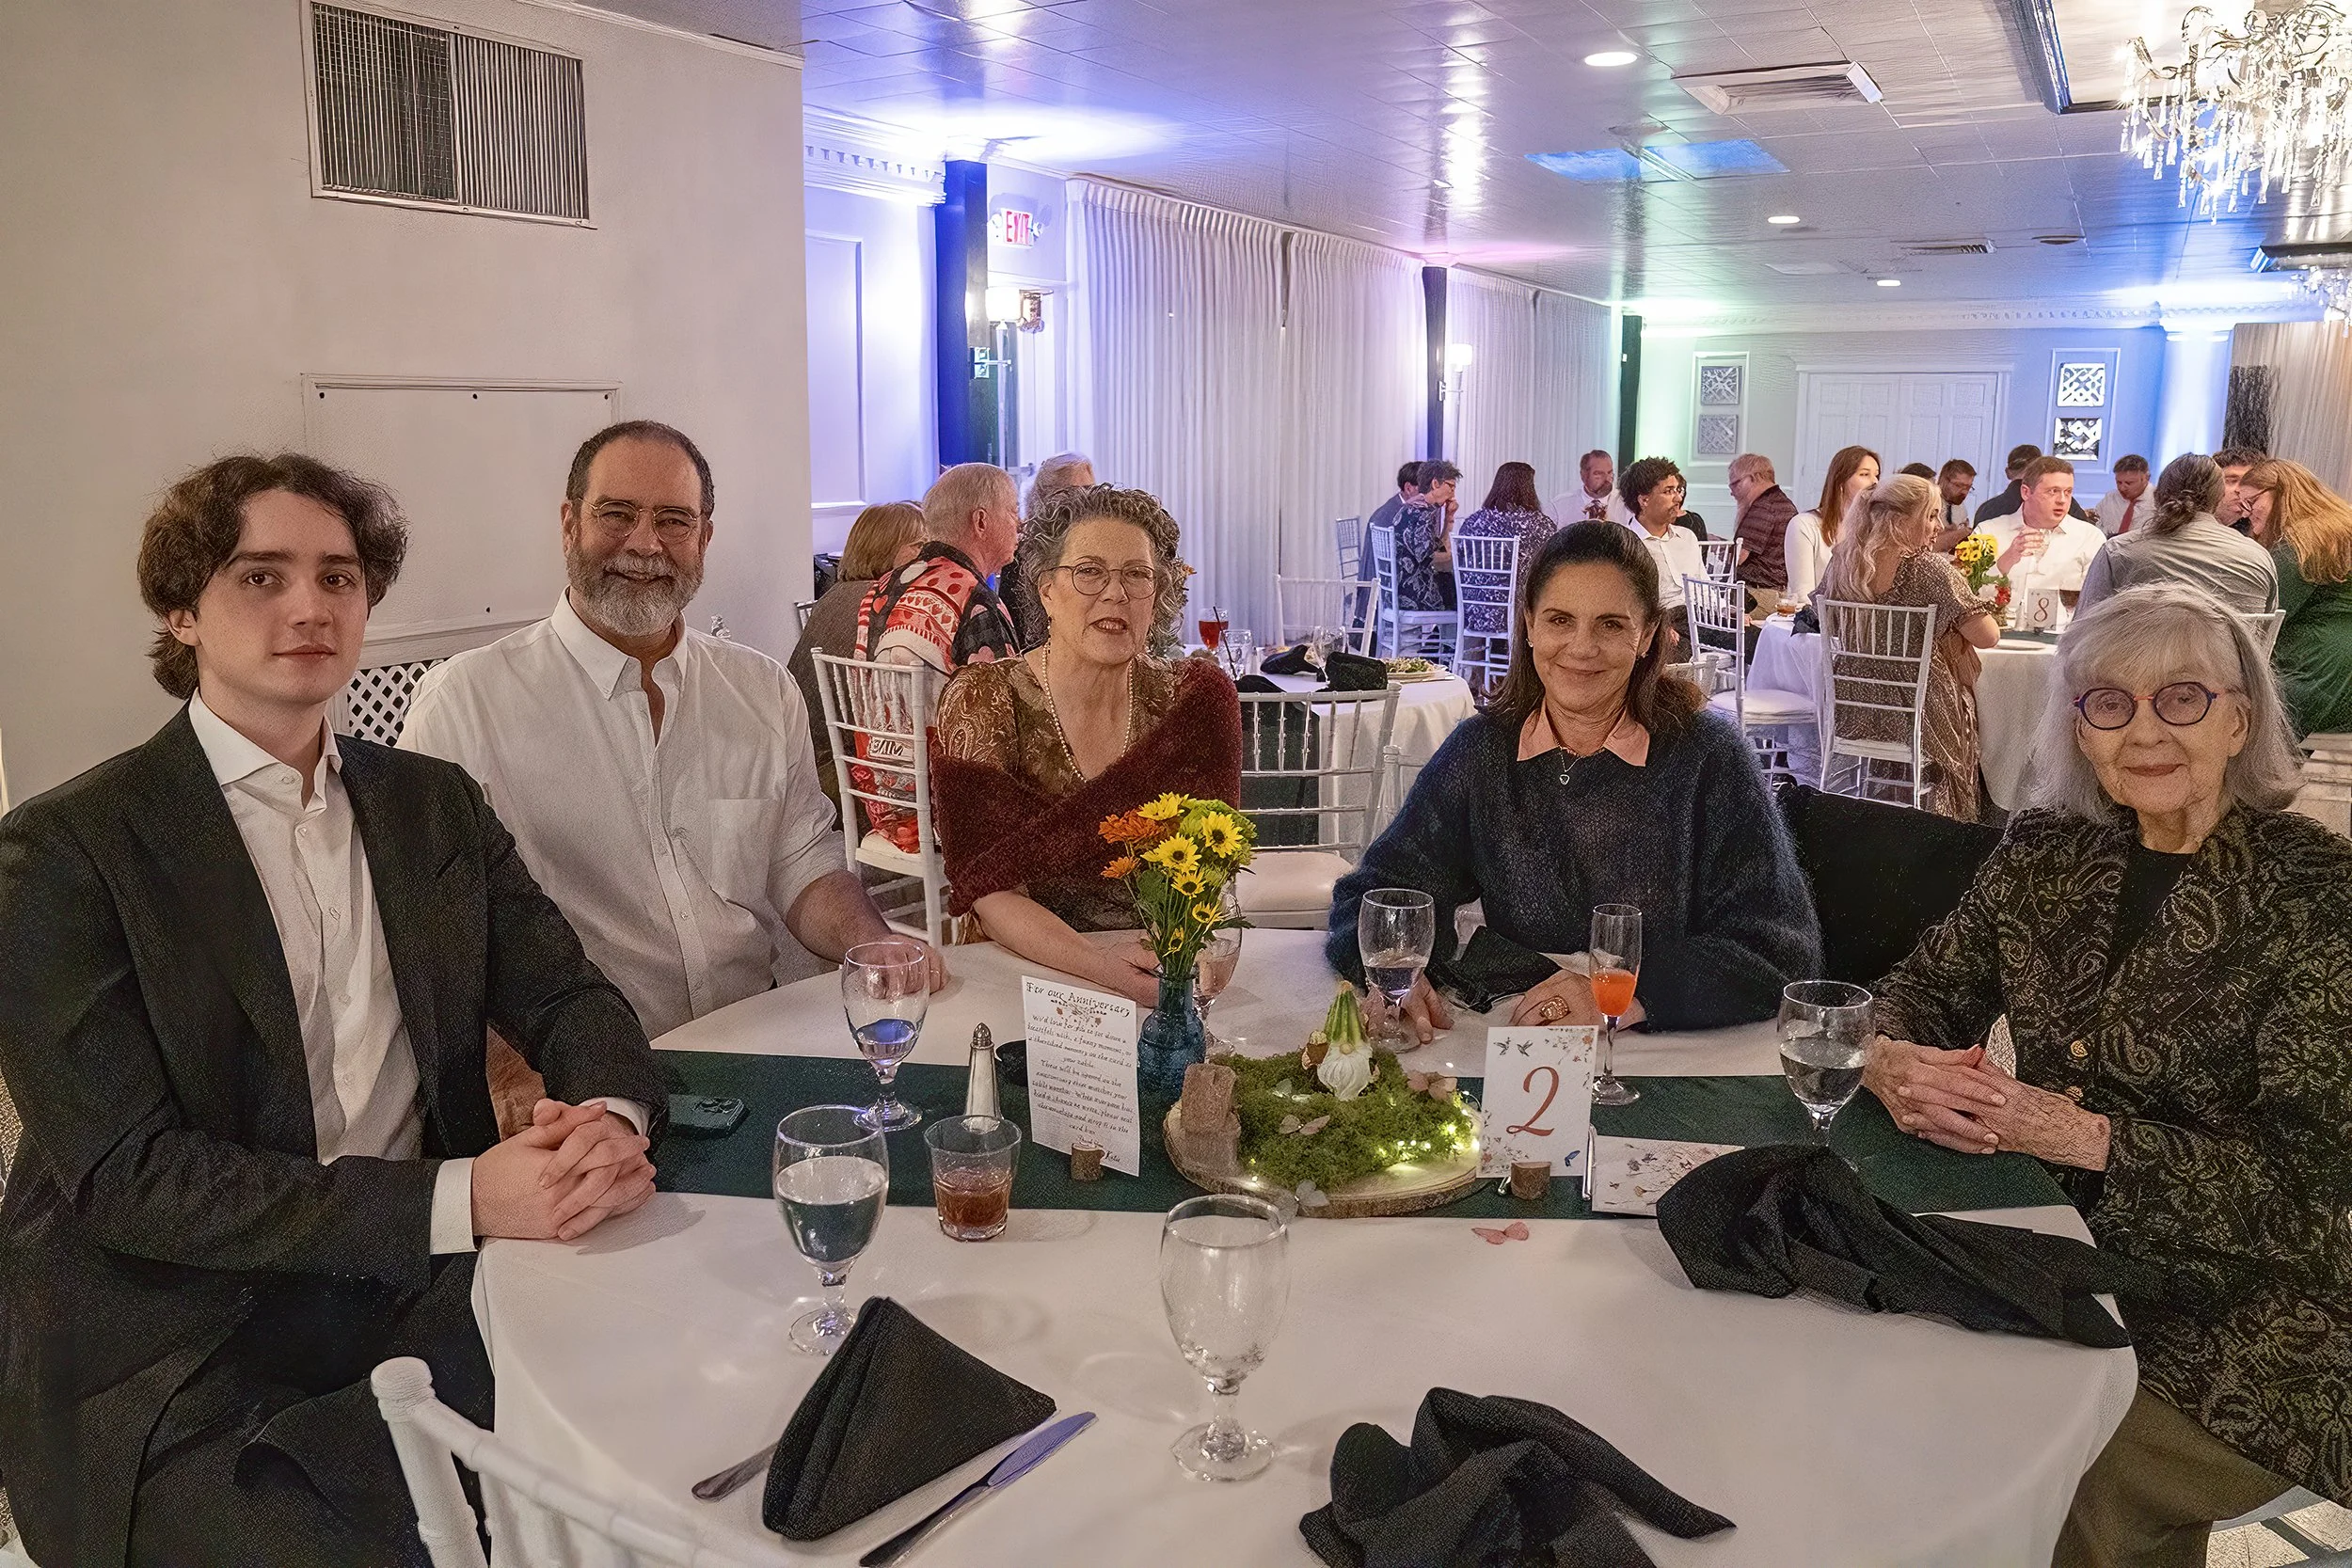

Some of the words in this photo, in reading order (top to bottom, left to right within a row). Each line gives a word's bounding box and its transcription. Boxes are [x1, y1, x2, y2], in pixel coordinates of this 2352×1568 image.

[1006, 210, 1030, 245] EXIT
[2033, 597, 2049, 622] 8
[1026, 981, 1044, 994] For
[1047, 990, 1067, 1004] our
[1068, 992, 1130, 1017] Anniversary
[1506, 1066, 1559, 1136] 2
